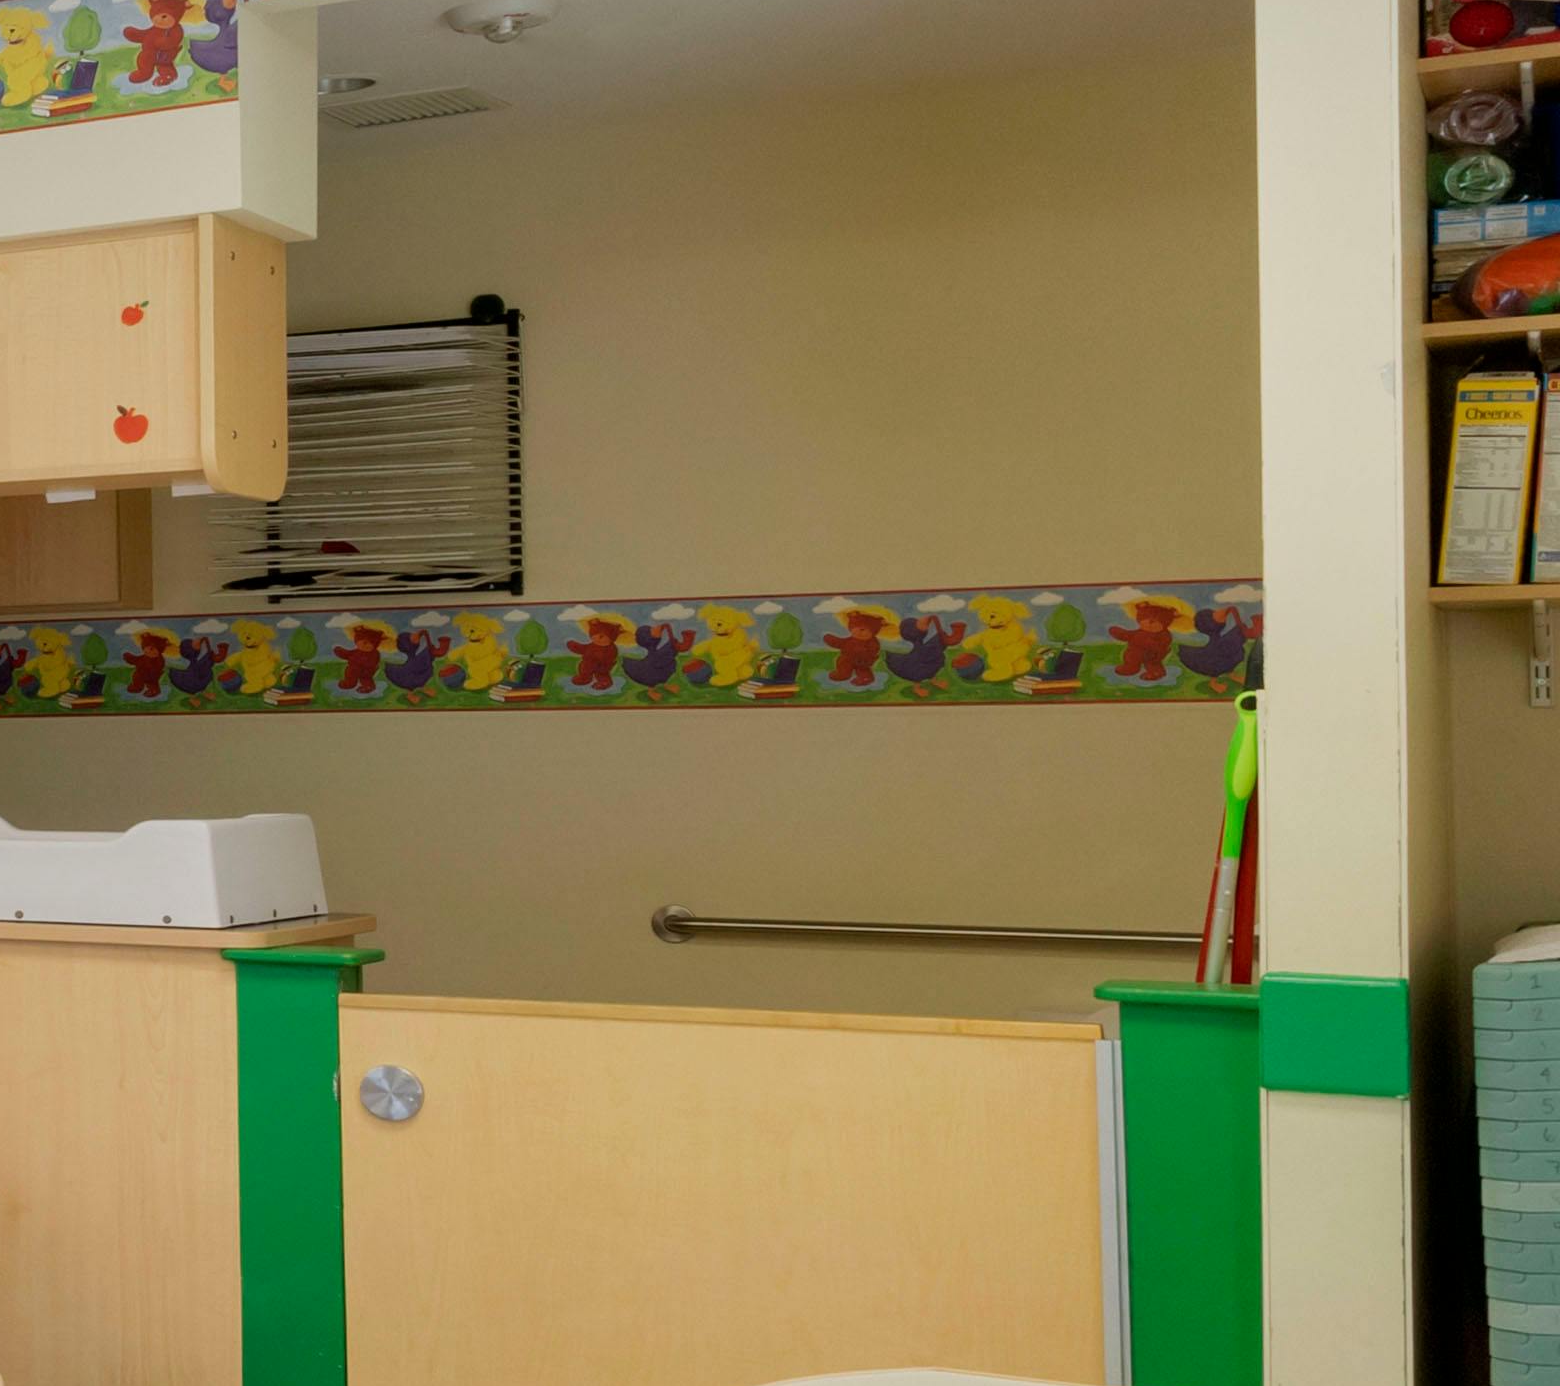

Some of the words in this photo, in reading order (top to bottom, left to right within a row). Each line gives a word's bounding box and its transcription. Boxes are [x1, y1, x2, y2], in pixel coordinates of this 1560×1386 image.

[1530, 974, 1542, 990] 1
[1540, 1067, 1551, 1083] 4
[1542, 1098, 1554, 1115] 5
